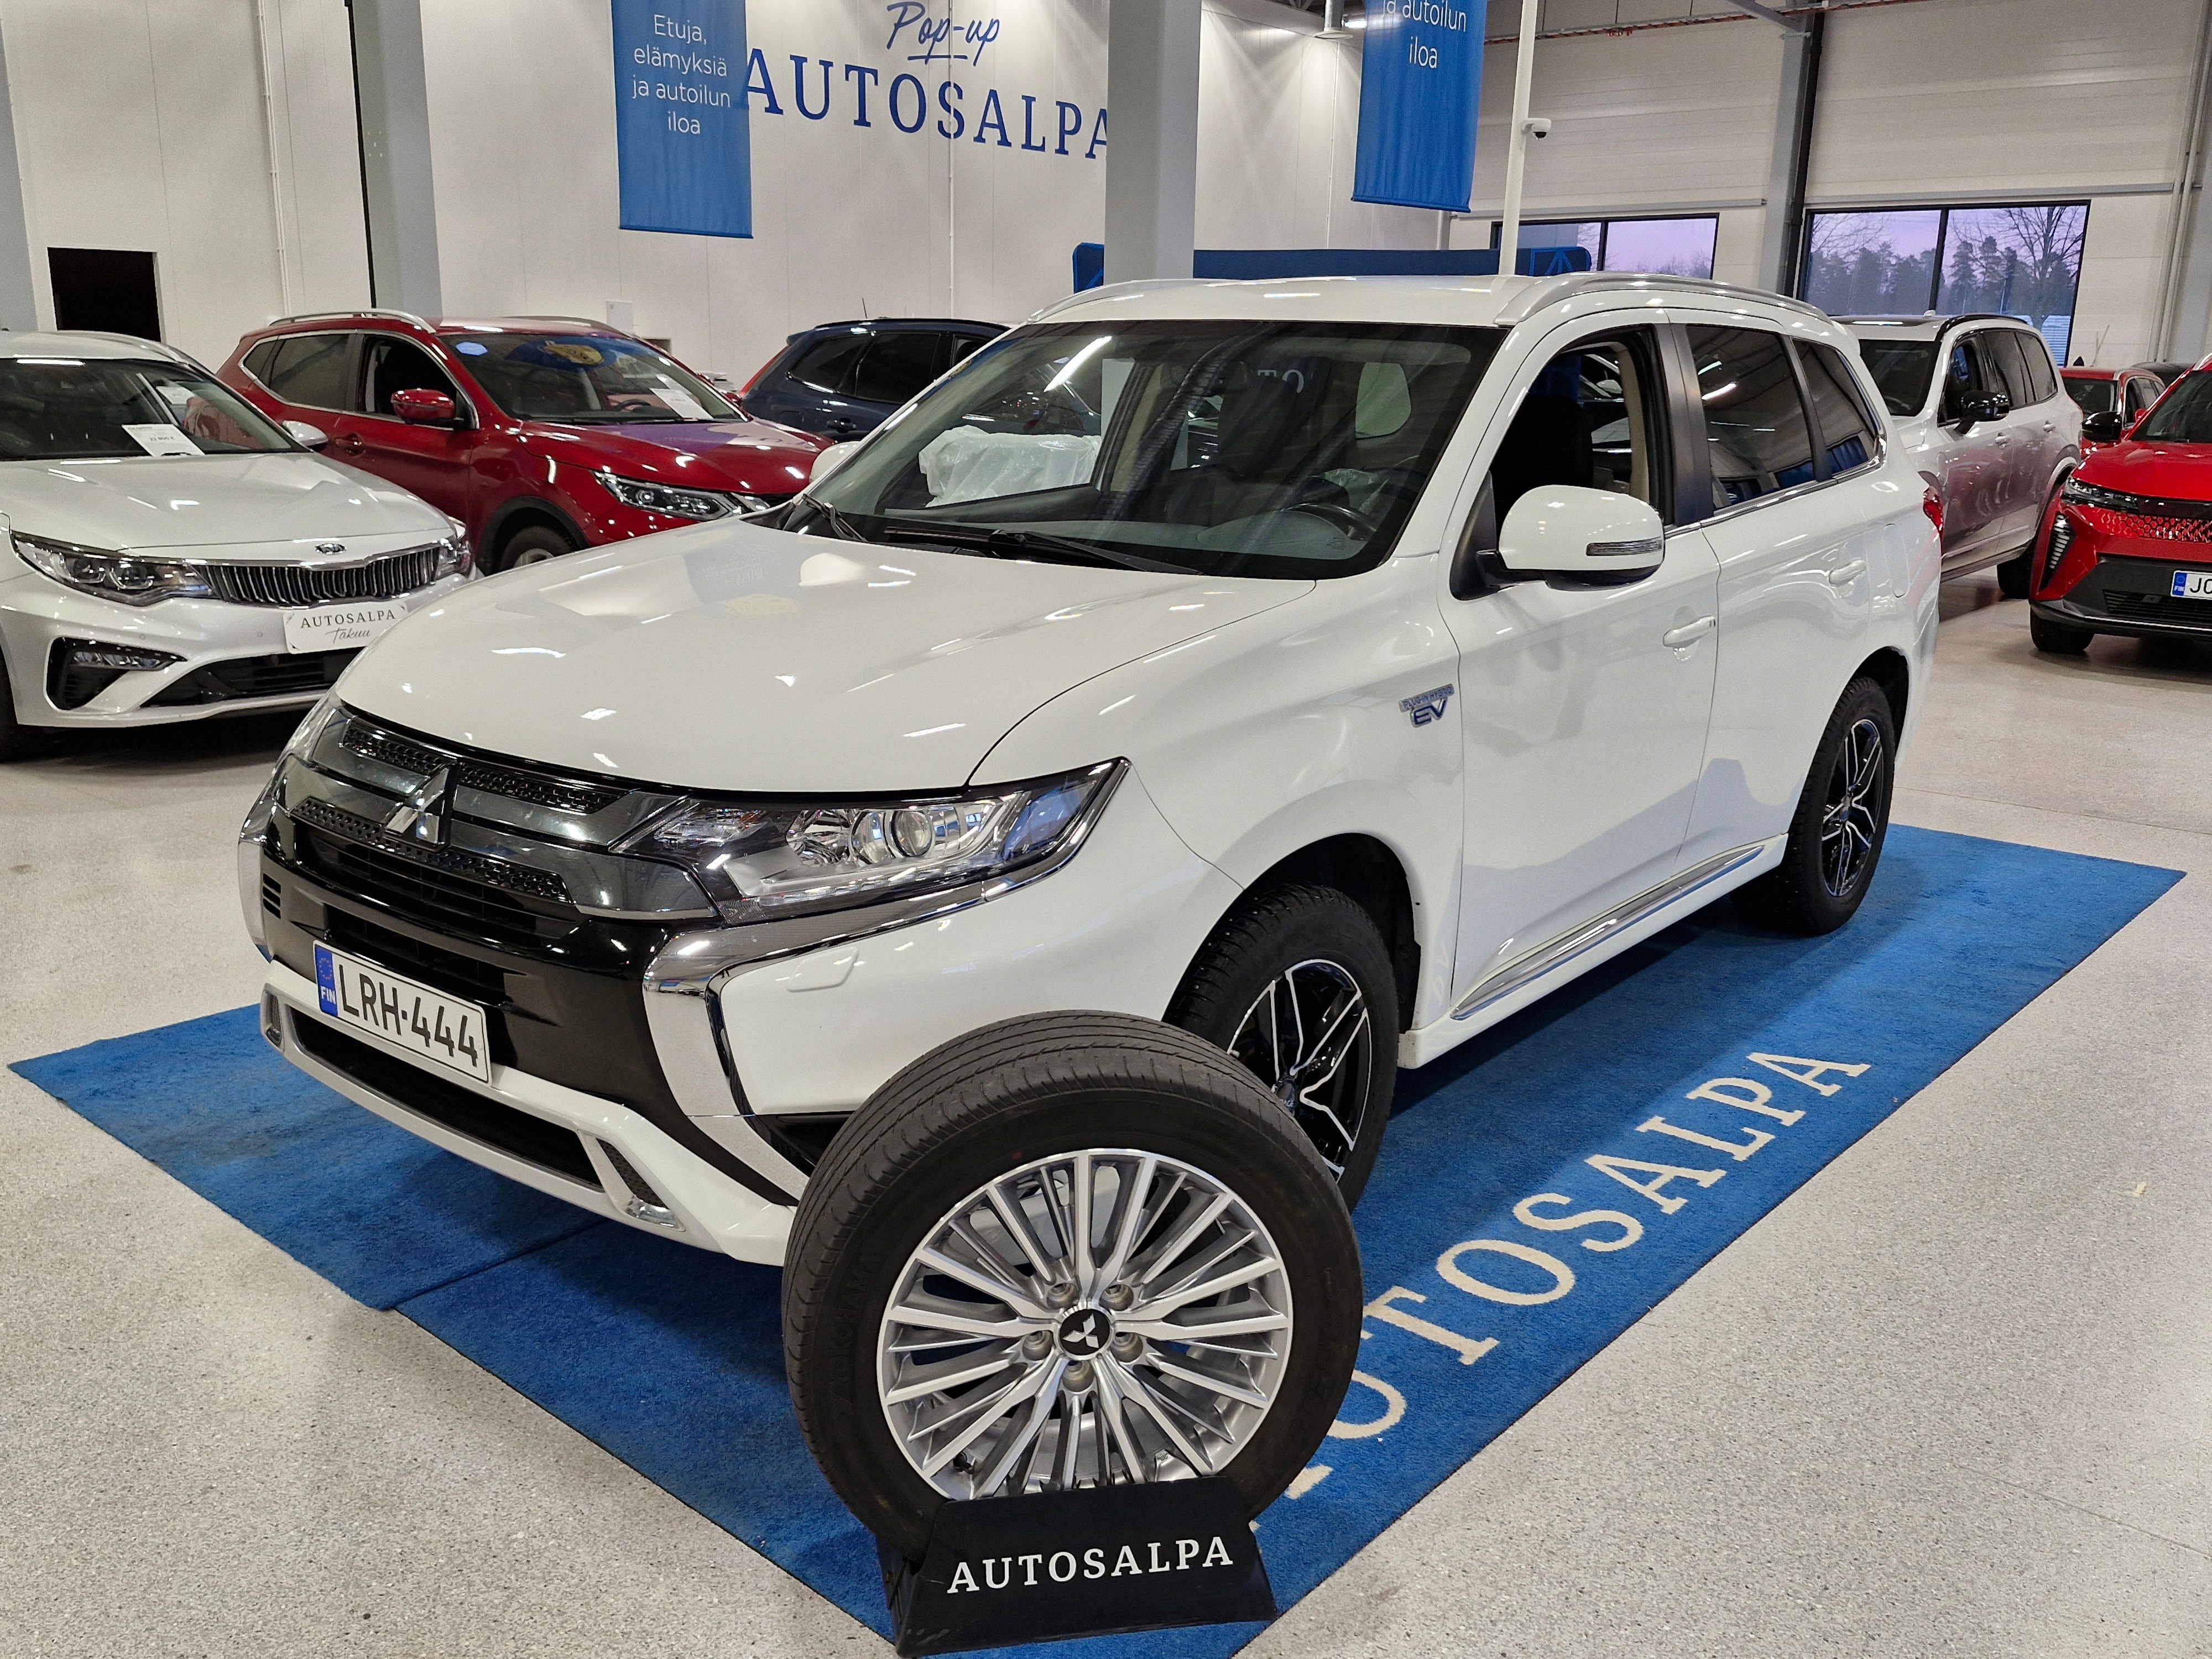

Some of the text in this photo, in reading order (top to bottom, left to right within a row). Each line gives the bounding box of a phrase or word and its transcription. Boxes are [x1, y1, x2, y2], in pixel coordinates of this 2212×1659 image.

[654, 14, 707, 45] Etuja,
[1402, 0, 1466, 32] autoilun
[886, 1, 1000, 66] Pop-up
[634, 44, 728, 77] elämyksiä
[1409, 36, 1438, 69] iloa
[632, 75, 731, 108] ja autoilun
[667, 111, 701, 134] iloa
[301, 609, 396, 629] AUTOSALPA
[325, 627, 371, 644] Takuu
[1410, 696, 1448, 728] EV
[320, 985, 337, 1005] FIN
[947, 1536, 1234, 1594] AUTOSALPA
